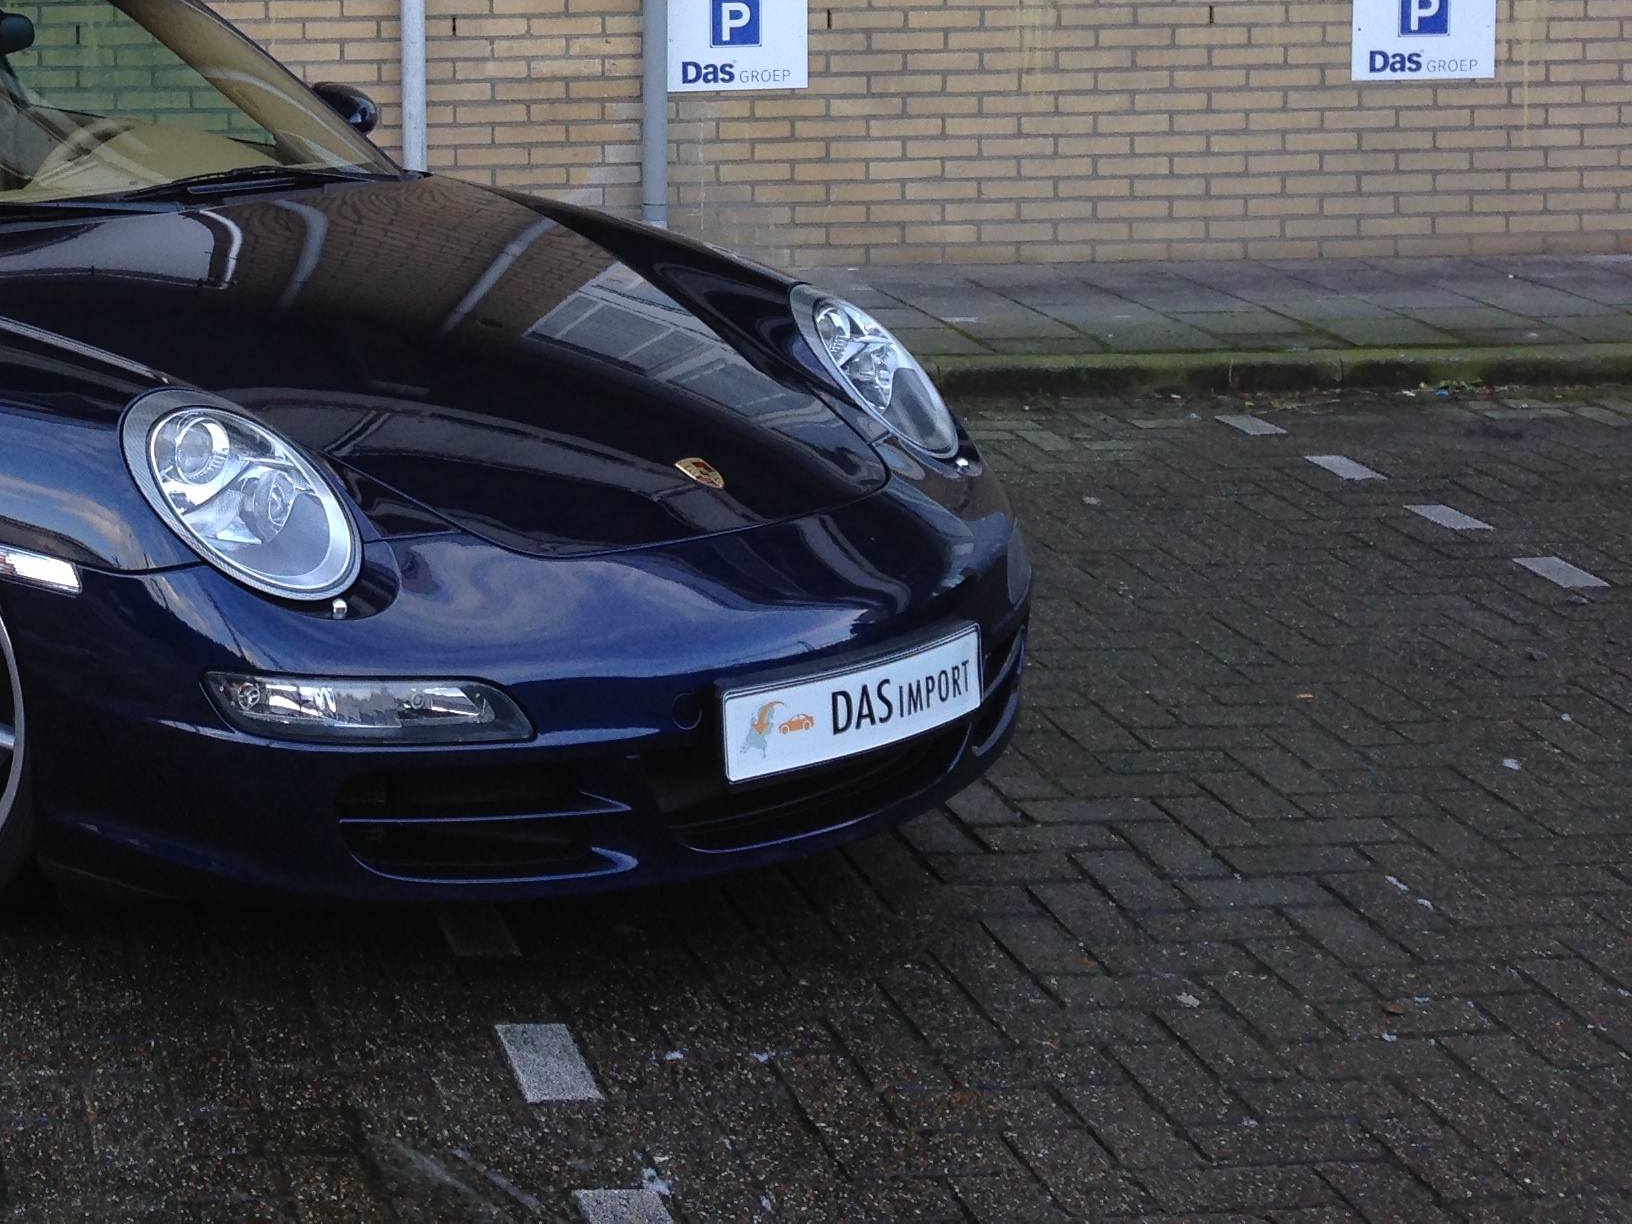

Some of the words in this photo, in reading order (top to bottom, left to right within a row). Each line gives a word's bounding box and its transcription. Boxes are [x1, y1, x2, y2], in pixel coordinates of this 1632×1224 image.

[721, 2, 751, 41] P
[682, 61, 735, 84] Das
[739, 69, 791, 83] GROEP
[1369, 50, 1422, 73] Das
[1426, 59, 1478, 72] GROEP
[831, 678, 894, 736] DAS
[898, 659, 969, 718] IMPORT
